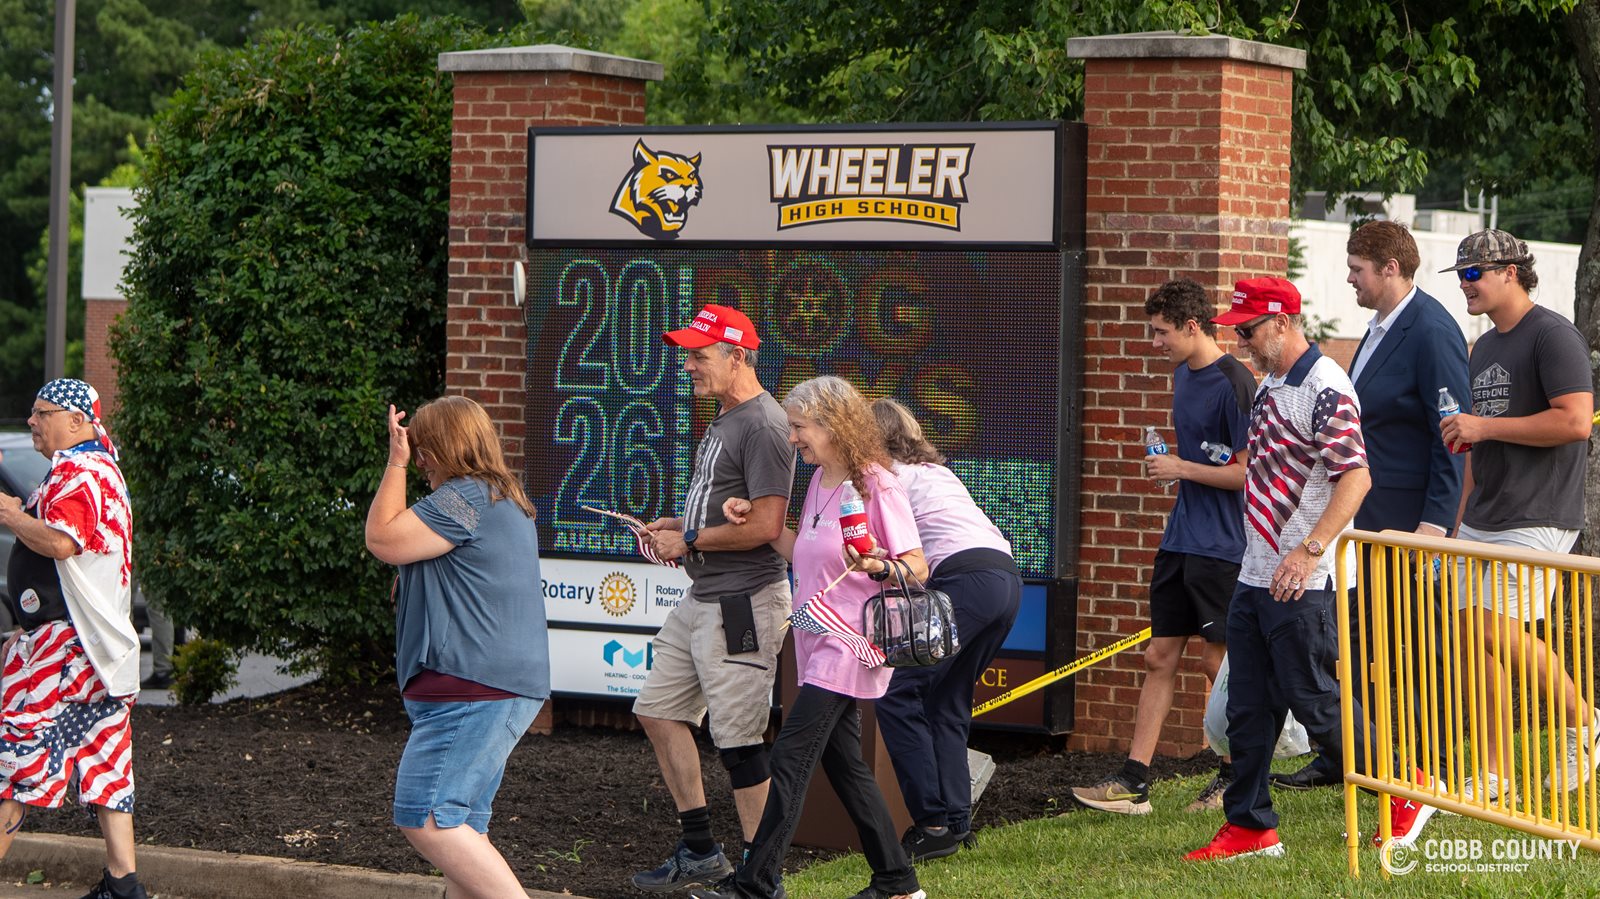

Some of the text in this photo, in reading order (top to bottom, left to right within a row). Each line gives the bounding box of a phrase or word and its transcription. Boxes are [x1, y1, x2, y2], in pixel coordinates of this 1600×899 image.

[770, 147, 970, 199] WHEELER
[789, 201, 951, 222] HIGH SCHOOL
[555, 258, 668, 396] 20
[553, 397, 664, 527] 26
[554, 531, 635, 553] AUGUS
[541, 579, 595, 604] Rotary
[655, 585, 685, 598] Rotary
[604, 671, 629, 679] HEATING
[976, 667, 1007, 687] CE
